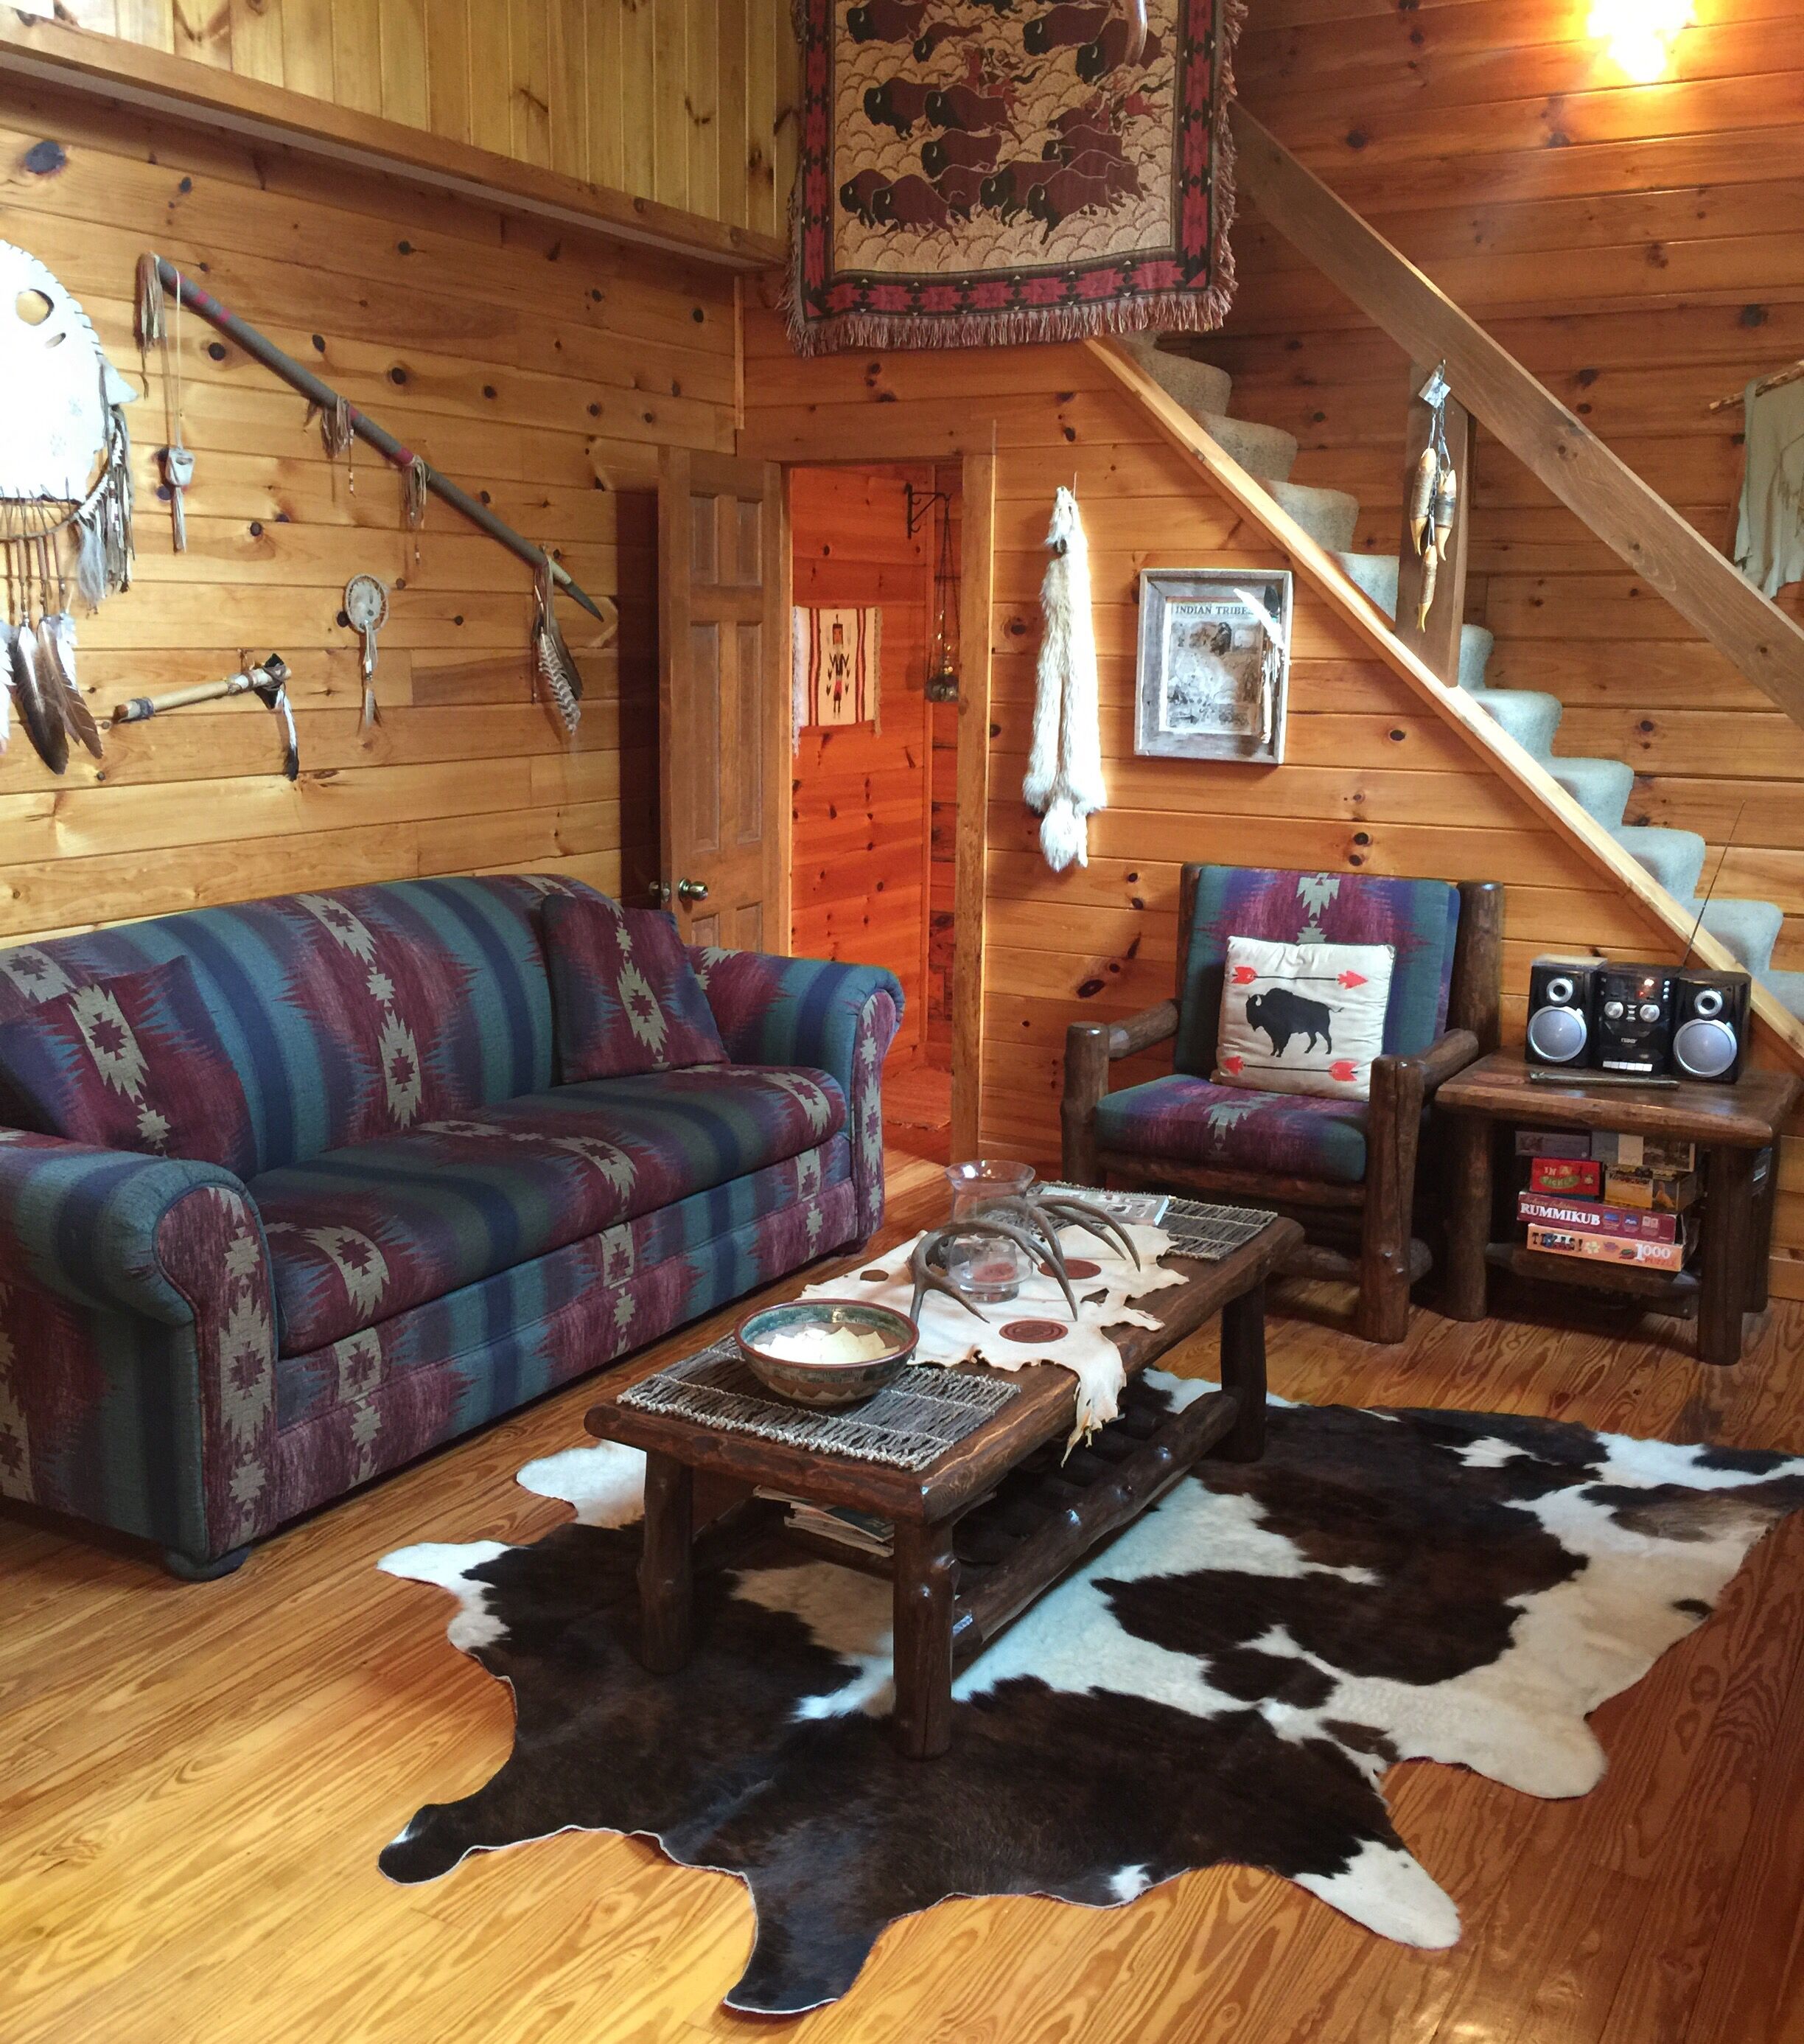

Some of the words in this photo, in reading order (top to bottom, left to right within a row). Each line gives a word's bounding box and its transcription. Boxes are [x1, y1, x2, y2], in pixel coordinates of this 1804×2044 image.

[1175, 605, 1212, 615] INDIAN
[1216, 606, 1254, 615] TRIBE
[1544, 1166, 1557, 1176] IN
[1520, 1203, 1601, 1226] RUMMIKUB
[1634, 1244, 1671, 1261] 1000
